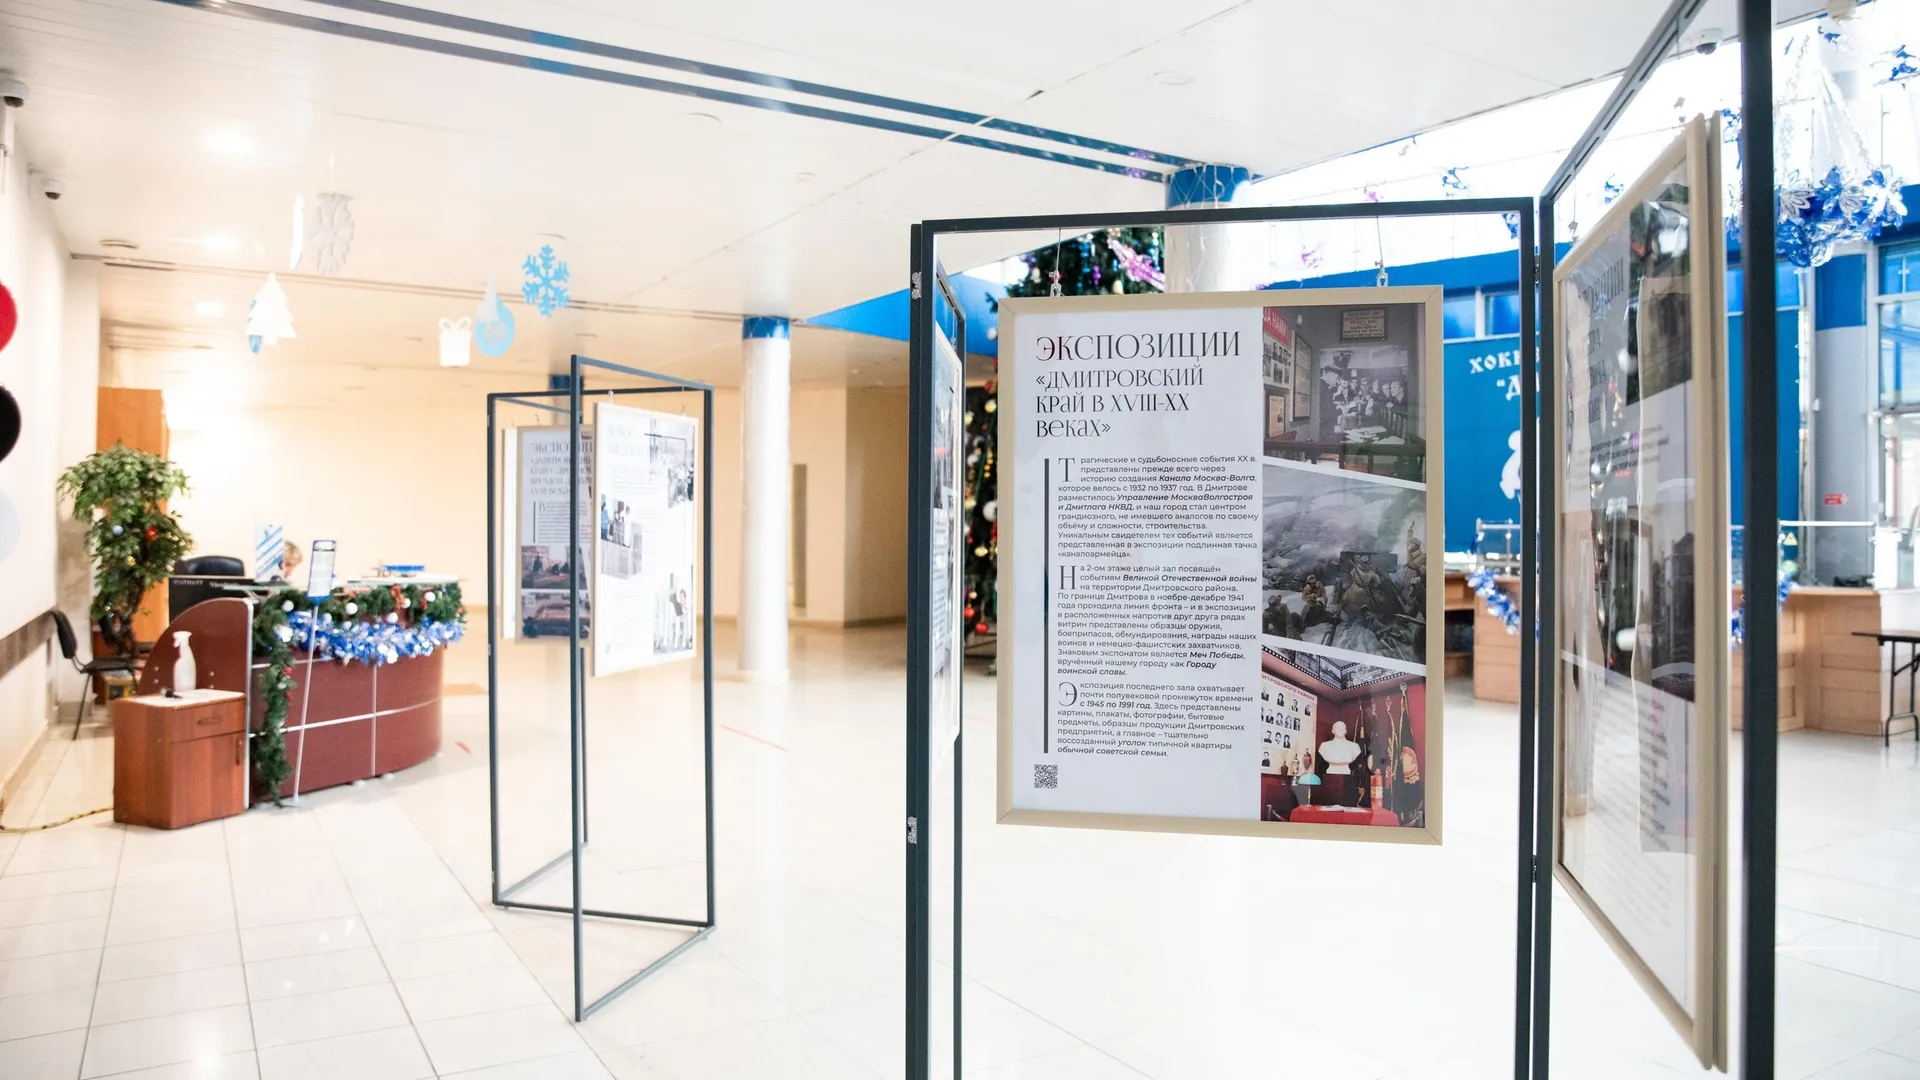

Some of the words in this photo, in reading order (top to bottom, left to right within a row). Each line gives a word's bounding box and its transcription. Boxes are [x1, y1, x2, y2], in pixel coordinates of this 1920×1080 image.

[1036, 331, 1241, 361] ЭКСПОЗИЦИИ
[1036, 364, 1204, 392] «ДМИТРОВСКИЙ
[1111, 393, 1190, 412] XVIII-XX
[1137, 454, 1197, 464] судьбоносные
[1199, 454, 1235, 462] события
[1237, 454, 1248, 462] XX
[1080, 466, 1139, 474] представлены
[1141, 466, 1174, 474] прежде
[1200, 466, 1225, 474] через
[1080, 475, 1116, 483] историю
[1117, 475, 1157, 483] создания
[1158, 473, 1191, 481] Канала
[1058, 485, 1091, 493] которое
[1129, 483, 1146, 491] 1932
[1159, 483, 1177, 491] 1937
[1179, 485, 1195, 493] год.
[1196, 483, 1203, 491] В
[1204, 483, 1247, 493] Дмитрове
[1058, 494, 1115, 502] разместилось
[1116, 492, 1169, 502] Управление
[1170, 492, 1253, 502] МоскваВолгостроя
[1064, 502, 1106, 512] Дмитлага
[1108, 502, 1134, 512] НКВД,
[1162, 504, 1187, 512] город
[1209, 504, 1246, 512] центром
[1227, 513, 1258, 521] своему
[1096, 522, 1143, 530] сложности,
[1057, 530, 1109, 540] Уникальным
[1110, 532, 1160, 540] свидетелем
[1176, 531, 1213, 539] событий
[1057, 541, 1125, 549] представленная
[1133, 542, 1183, 550] экспозиции
[1185, 542, 1232, 550] подлинная
[1086, 563, 1105, 571] 2-ом
[1133, 564, 1160, 573] целый
[1079, 572, 1120, 580] событиям
[1122, 573, 1159, 581] Великой
[1161, 573, 1227, 582] Отечественной
[1228, 574, 1257, 582] войны
[1091, 584, 1141, 592] территории
[1142, 582, 1203, 593] Дмитровского
[1204, 583, 1238, 593] района.
[1057, 591, 1069, 599] По
[1070, 593, 1105, 601] границе
[1106, 592, 1148, 602] Дмитрова
[1156, 592, 1226, 603] ноябре-декабре
[1227, 593, 1244, 601] 1941
[1057, 602, 1075, 610] года
[1077, 602, 1121, 611] проходила
[1151, 602, 1182, 612] фронта
[1204, 604, 1255, 613] экспозиции
[1064, 611, 1130, 620] расположенных
[1132, 612, 1171, 621] напротив
[1173, 613, 1193, 621] друг
[1193, 614, 1218, 622] друга
[1220, 614, 1245, 622] рядах
[1057, 621, 1087, 629] витрин
[1088, 621, 1148, 630] представлены
[1149, 620, 1186, 631] образцы
[1187, 623, 1222, 631] оружия,
[1191, 633, 1227, 641] награды
[1096, 639, 1186, 650] немецко-фашистских
[1057, 647, 1098, 656] Знаковым
[1189, 650, 1207, 658] Меч
[1208, 650, 1245, 661] Победы,
[1104, 659, 1137, 668] нашему
[1139, 660, 1168, 668] городу
[1185, 659, 1217, 670] Городу
[1057, 666, 1097, 674] воинской
[1125, 683, 1174, 692] последнего
[1105, 690, 1159, 701] полувековой
[1161, 693, 1213, 703] промежуток
[1215, 695, 1253, 704] времени
[1086, 699, 1104, 707] 1945
[1118, 700, 1134, 708] 1991
[1135, 702, 1152, 710] год.
[1153, 701, 1178, 711] Здесь
[1180, 703, 1241, 713] представлены
[1057, 709, 1094, 718] картины,
[1095, 710, 1131, 719] плакаты,
[1132, 710, 1186, 721] фотографии,
[1187, 711, 1224, 720] бытовые
[1057, 718, 1100, 728] предметы,
[1101, 718, 1137, 729] образцы
[1139, 721, 1186, 730] продукции
[1187, 721, 1244, 732] Дмитровских
[1163, 731, 1208, 741] тщательно
[1057, 735, 1116, 747] воссозданный
[1117, 739, 1146, 748] уголок
[1148, 739, 1189, 748] типичной
[1190, 742, 1231, 751] квартиры
[1057, 745, 1094, 754] обычной
[1095, 746, 1138, 755] советской
